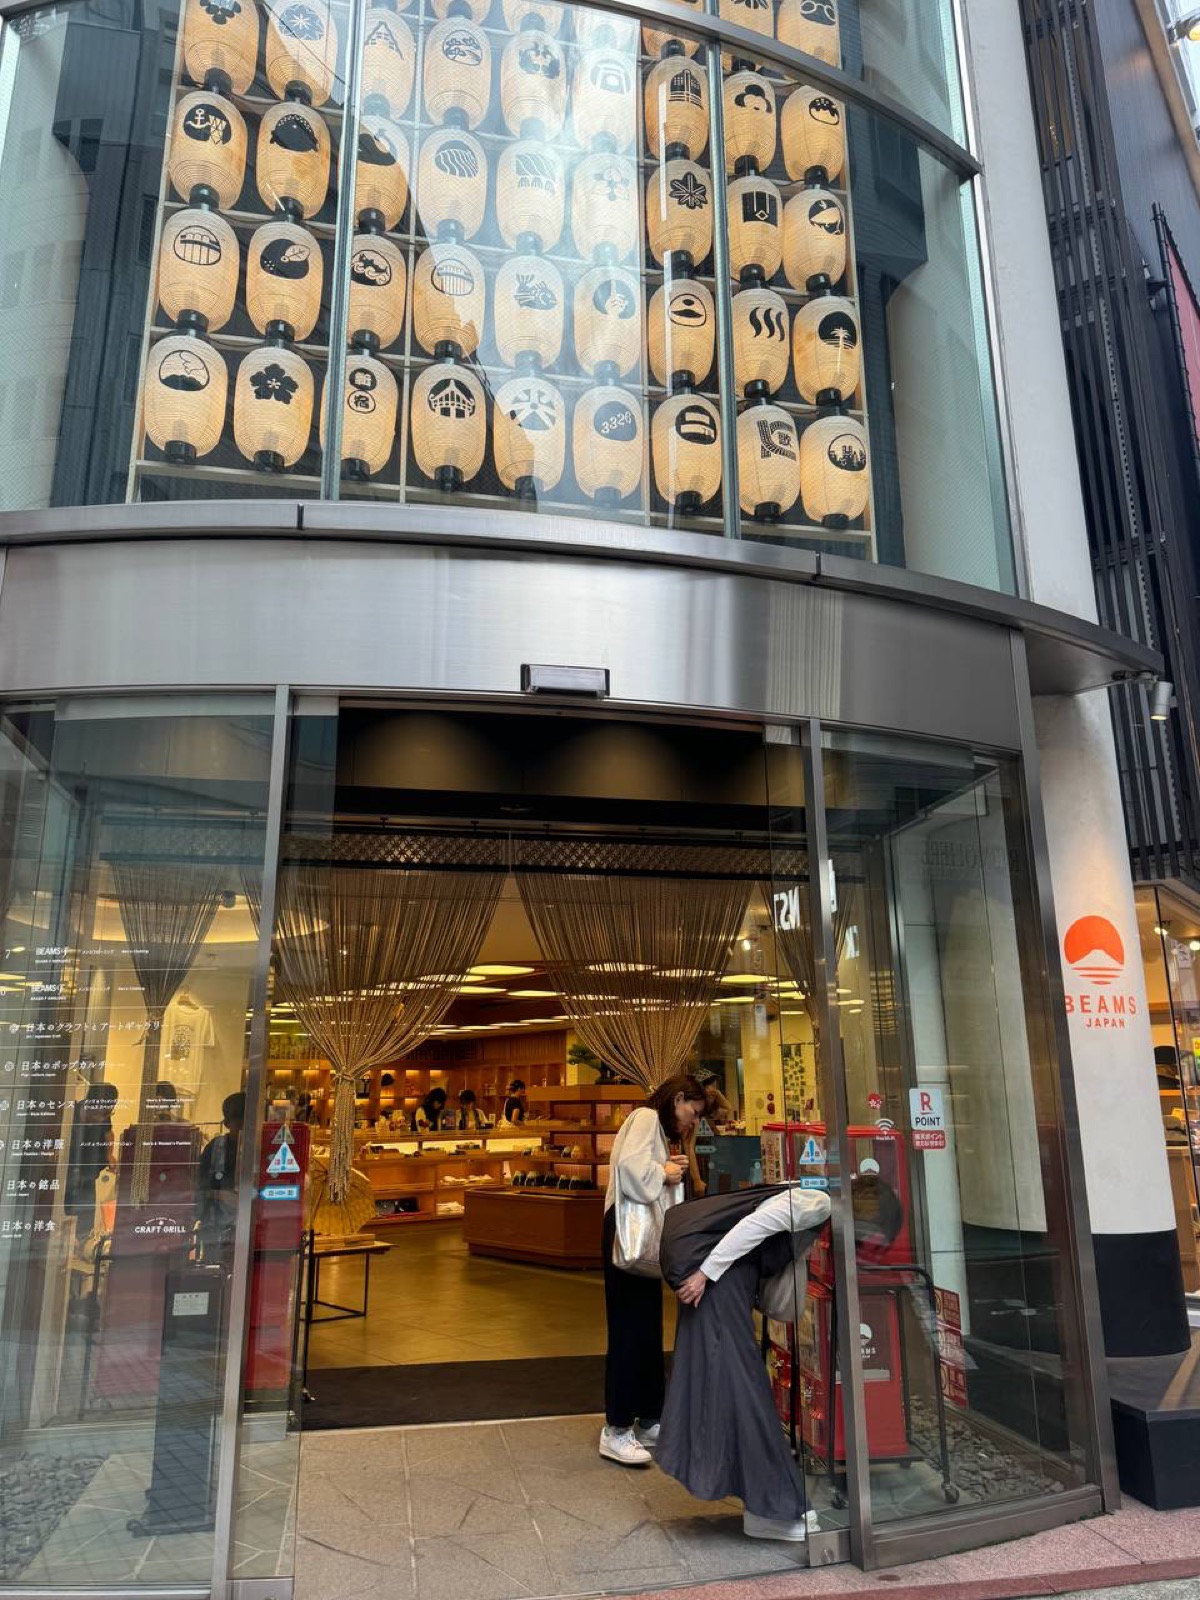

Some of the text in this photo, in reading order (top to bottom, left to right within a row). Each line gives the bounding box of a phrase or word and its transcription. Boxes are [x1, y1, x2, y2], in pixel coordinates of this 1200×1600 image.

[35, 946, 61, 956] BEAMS
[1065, 994, 1137, 1015] BEAMS
[1086, 1018, 1126, 1028] JAPAN
[17, 1098, 76, 1110] 日本のセンス
[919, 1091, 933, 1111] R
[915, 1117, 940, 1126] POINT
[11, 1138, 65, 1150] 日本の洋服
[6, 1179, 60, 1191] 日本の銘品
[1, 1219, 56, 1232] 日本の洋食
[134, 1225, 187, 1234] CRAFT GRILL
